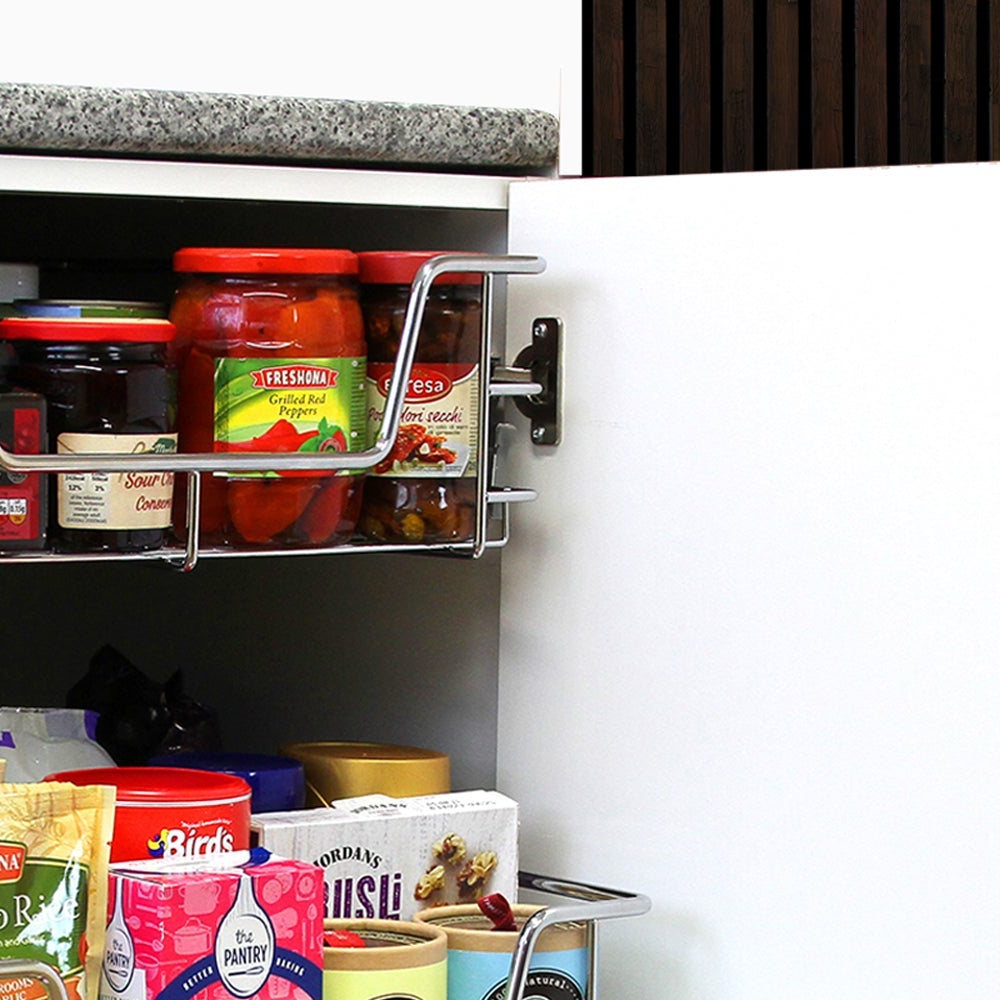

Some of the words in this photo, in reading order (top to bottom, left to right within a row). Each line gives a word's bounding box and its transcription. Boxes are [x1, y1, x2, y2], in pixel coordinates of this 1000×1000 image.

[266, 369, 327, 386] FRESHONA
[385, 379, 444, 393] resa
[269, 393, 306, 406] Grilled
[308, 393, 327, 404] Red
[279, 405, 318, 419] Peppers
[426, 407, 464, 423] secchi
[124, 471, 160, 490] Sour
[163, 826, 234, 861] Bird's
[235, 929, 254, 944] the
[106, 950, 131, 969] PANTRY
[223, 945, 268, 967] PANTRY
